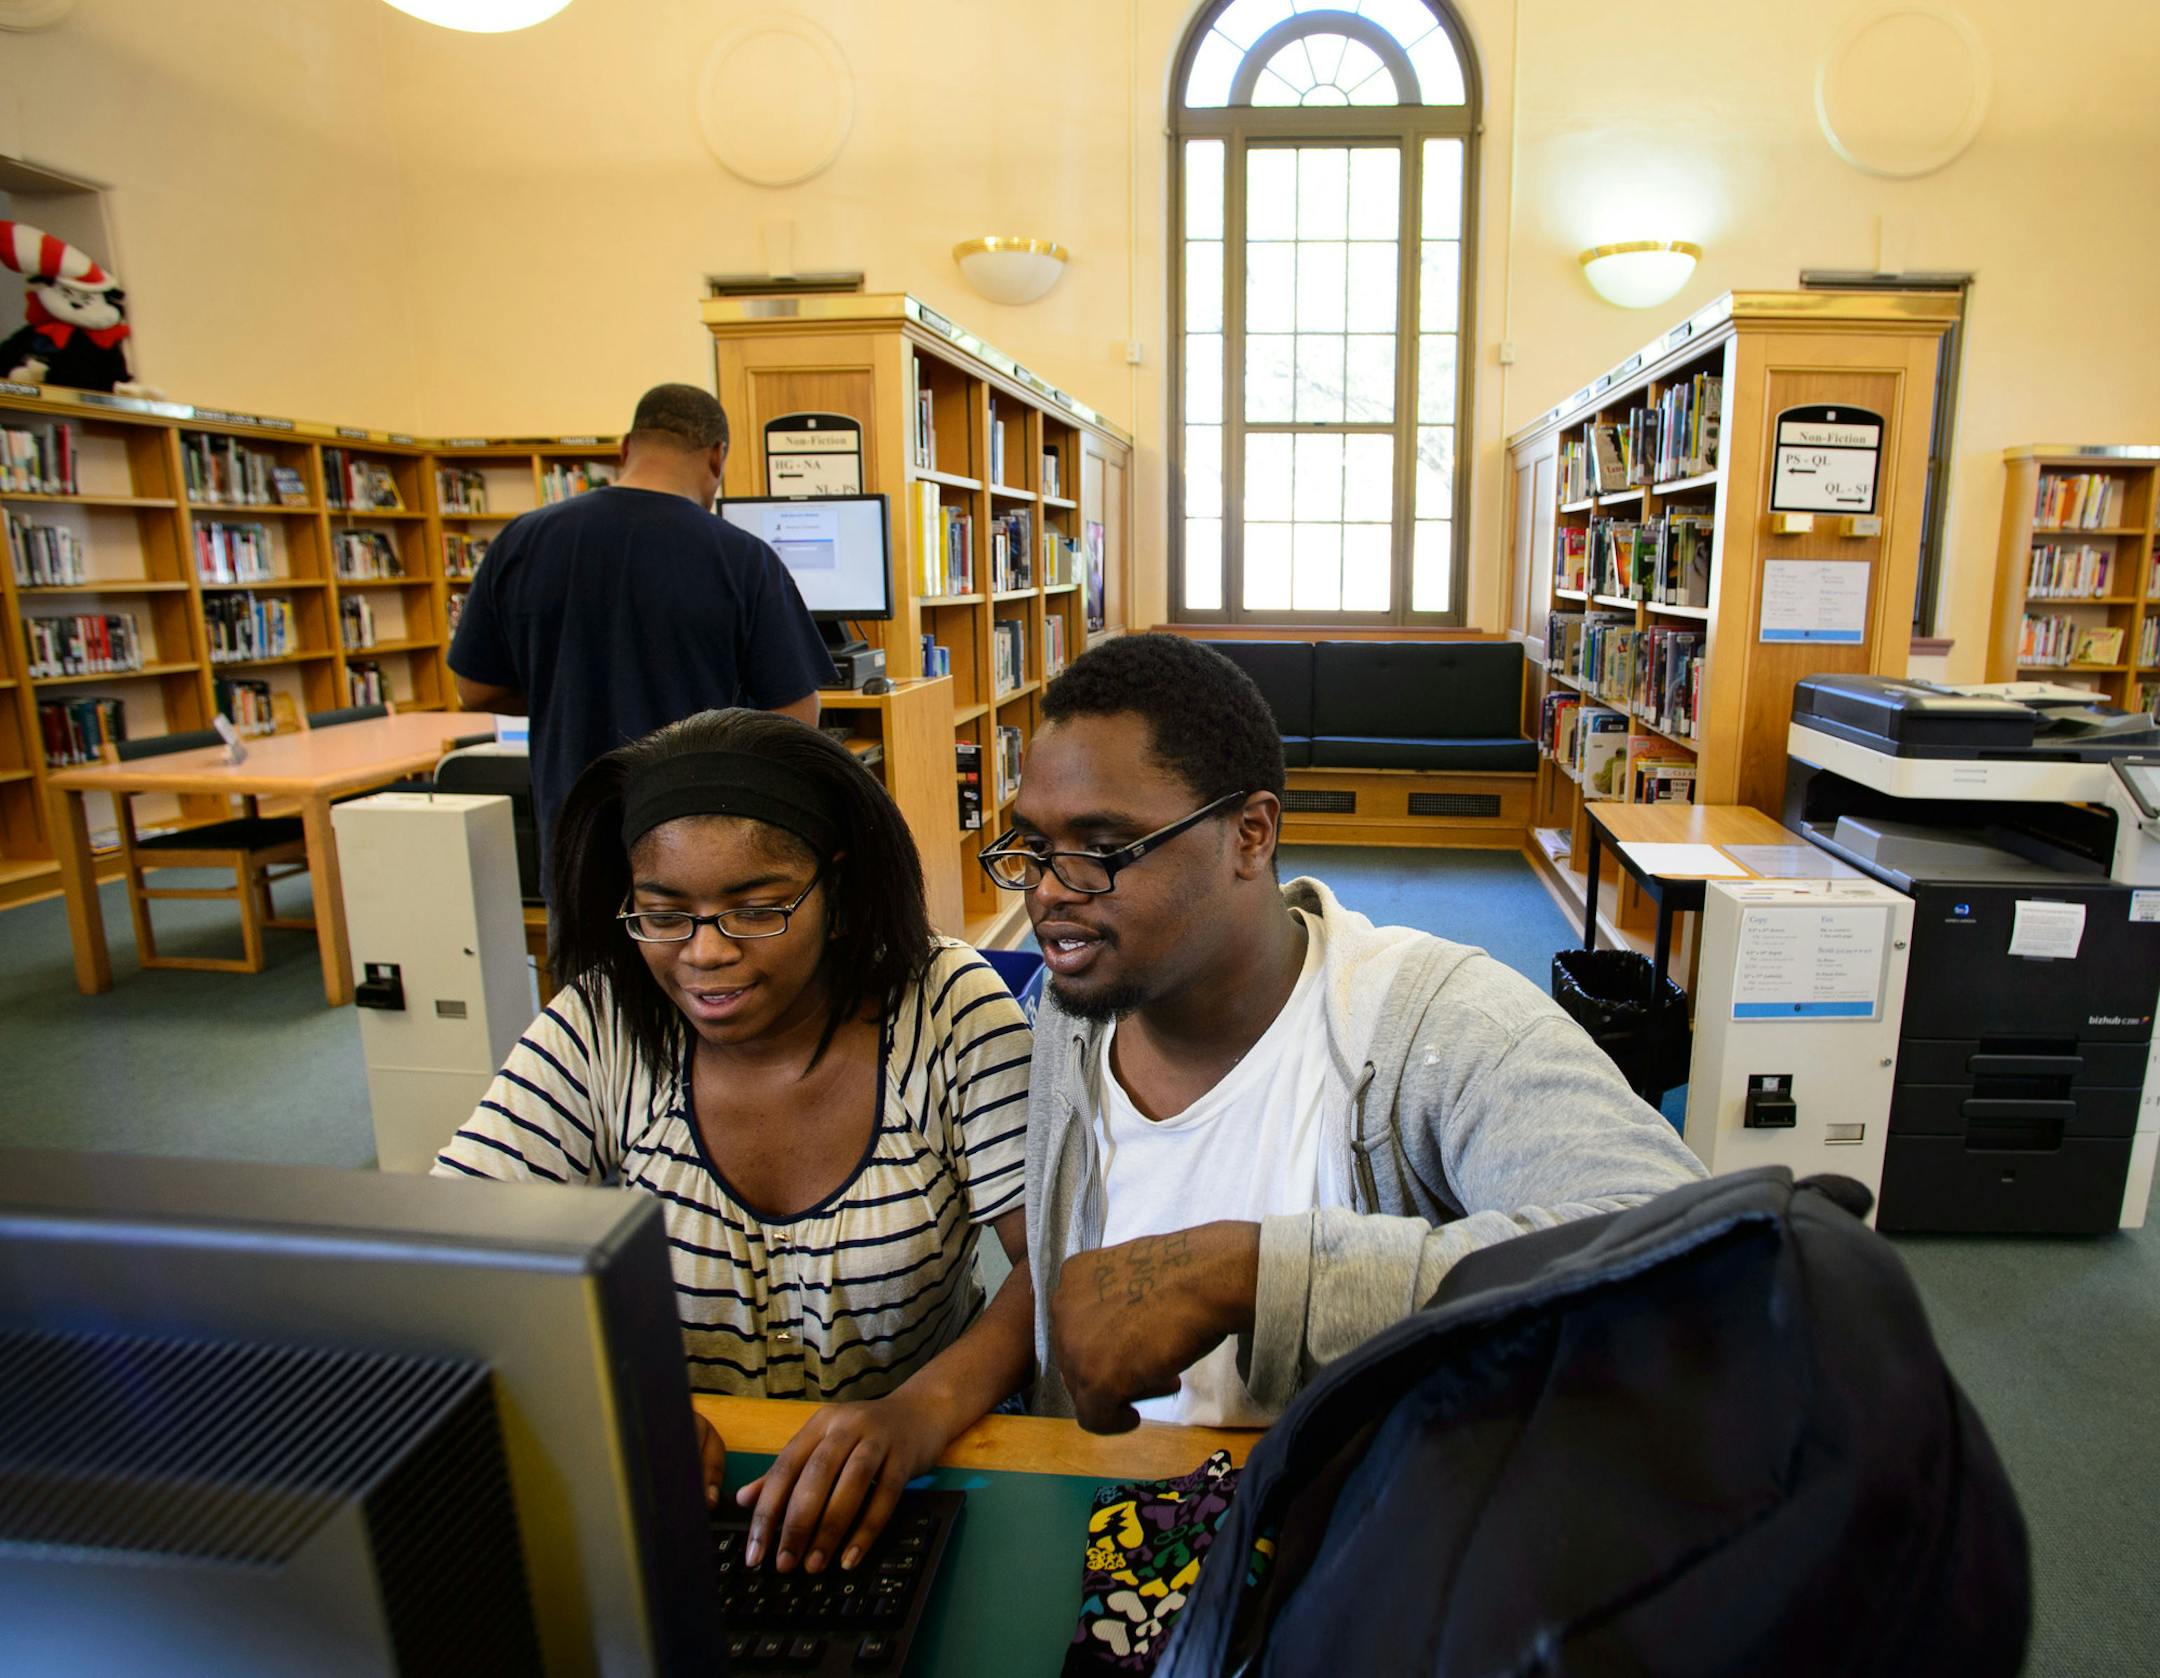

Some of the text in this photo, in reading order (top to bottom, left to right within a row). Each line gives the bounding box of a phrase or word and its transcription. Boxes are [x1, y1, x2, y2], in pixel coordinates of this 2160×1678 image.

[785, 436, 847, 446] Non-Fiction
[1800, 431, 1867, 444] Non-Fiction
[804, 460, 821, 470] NA
[1786, 454, 1801, 464] PS
[1812, 455, 1831, 467] QL
[1825, 483, 1845, 495] QL
[2088, 1015, 2121, 1025] bizhub
